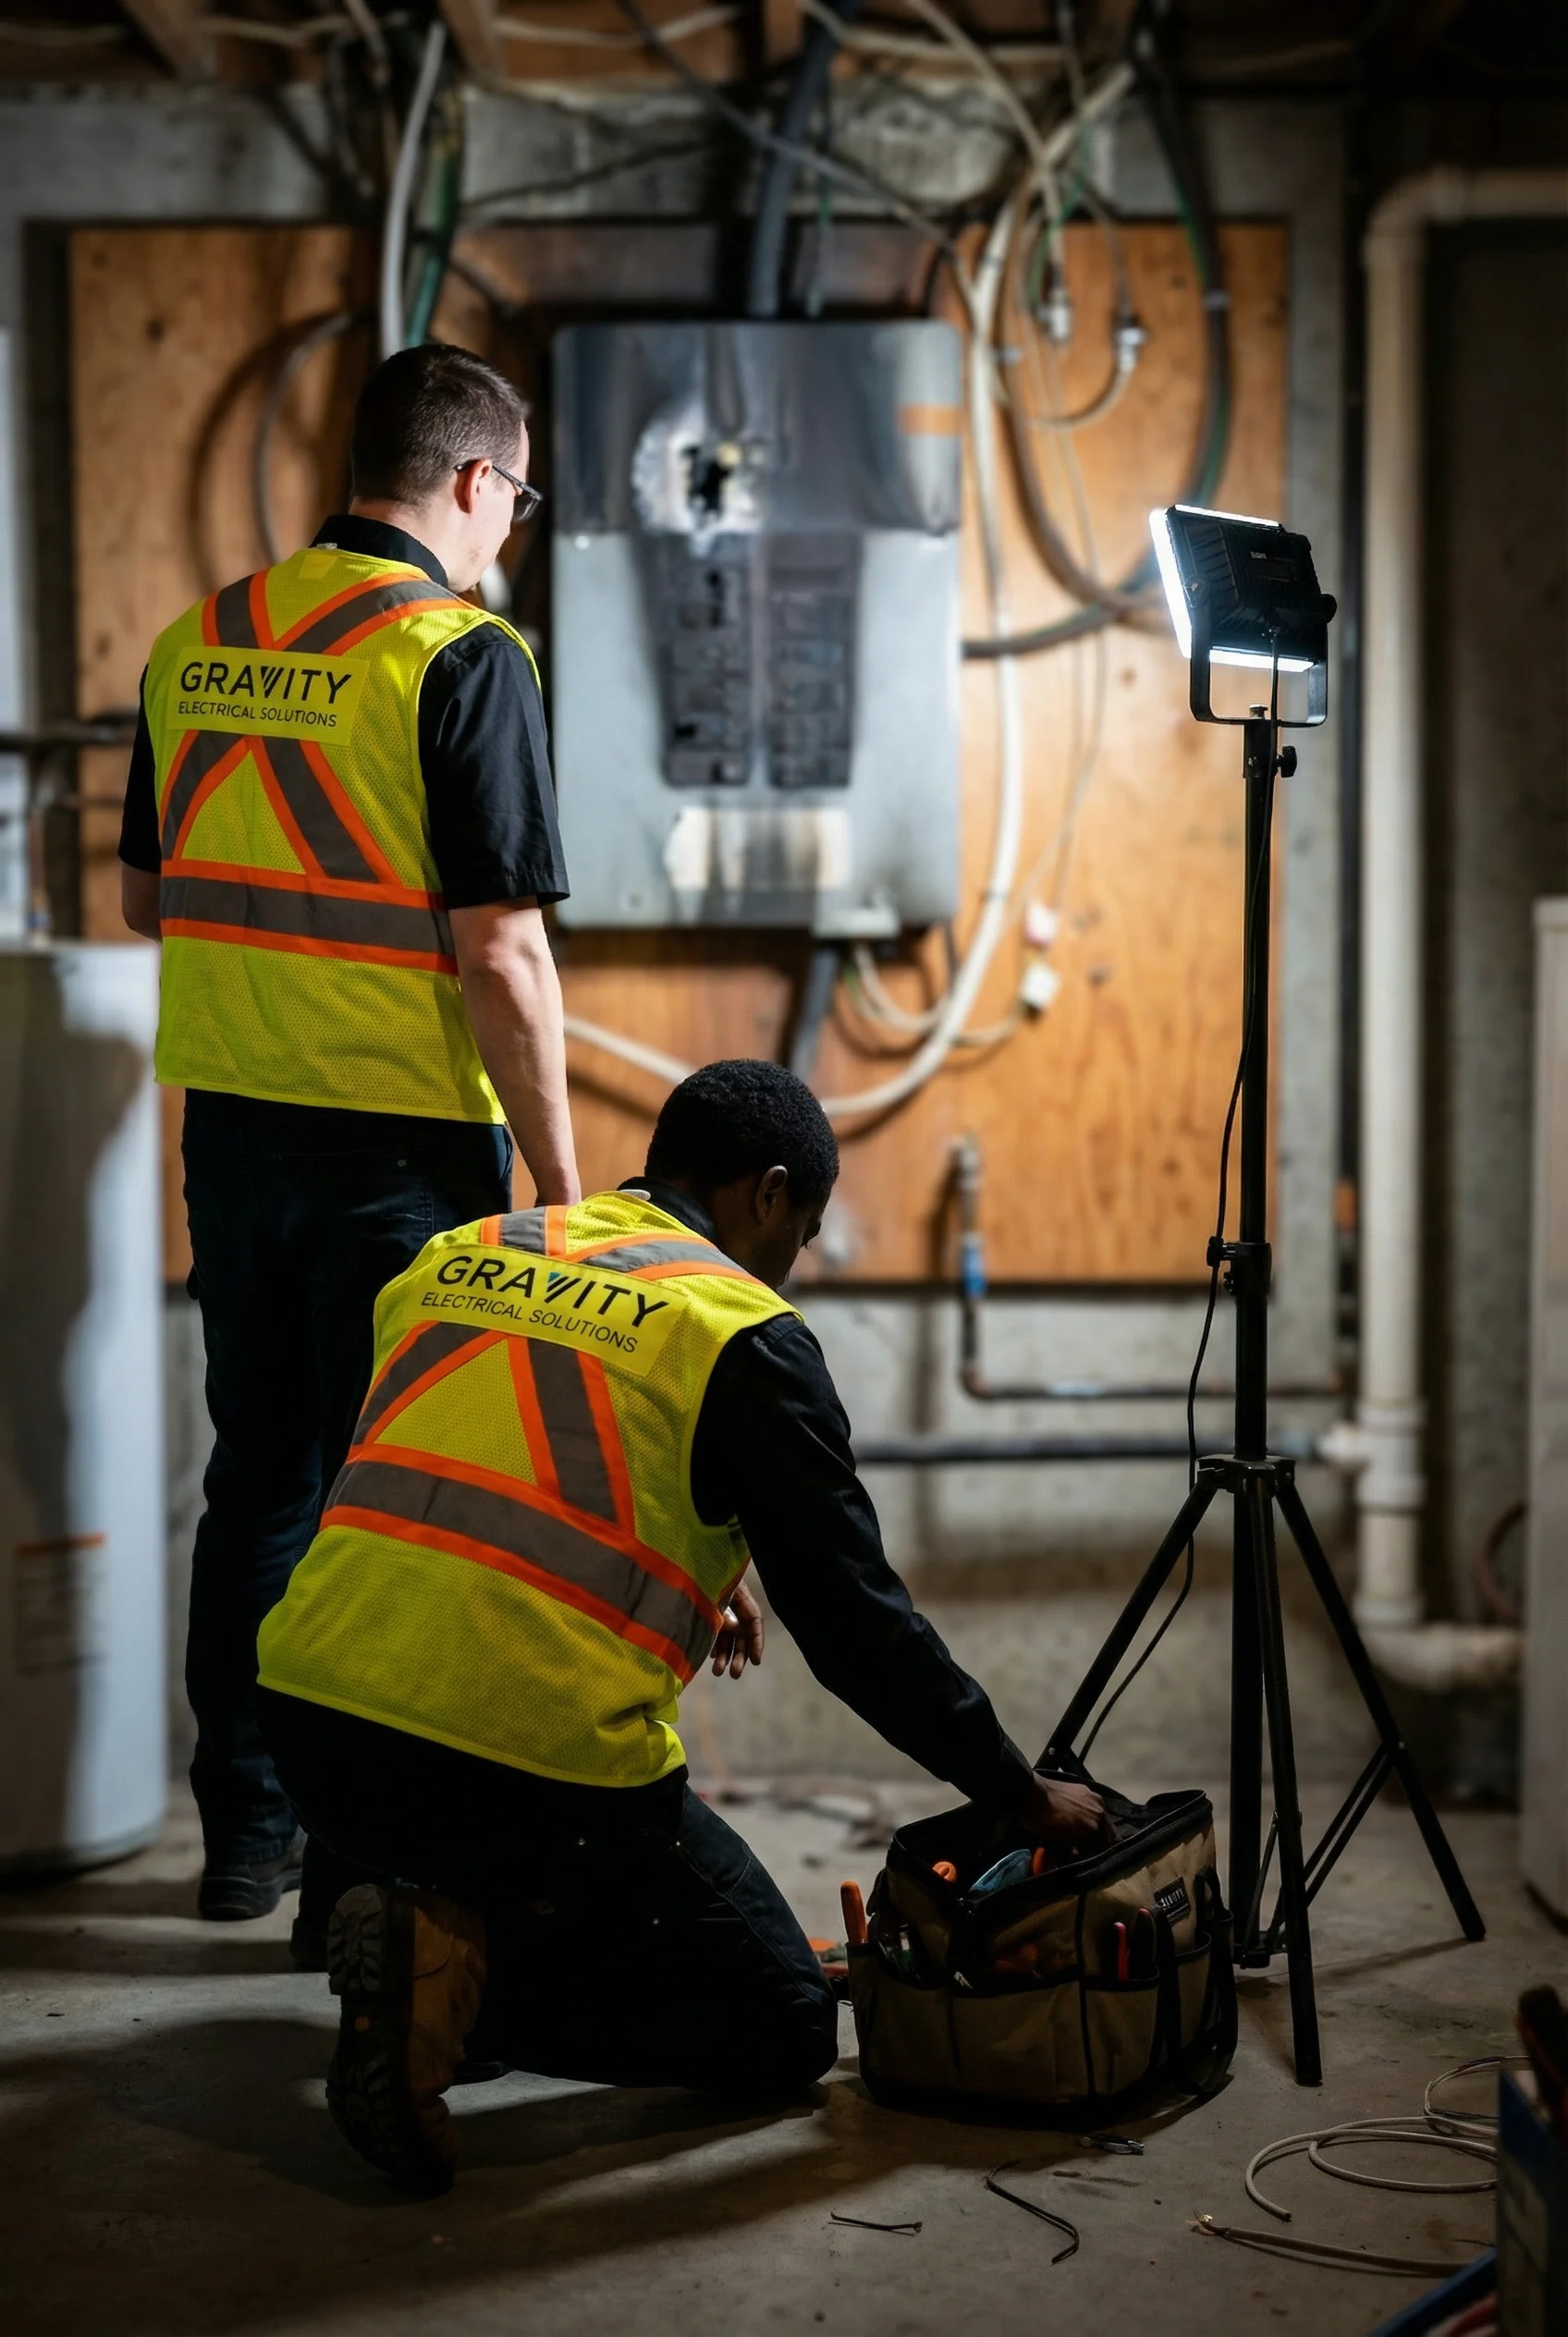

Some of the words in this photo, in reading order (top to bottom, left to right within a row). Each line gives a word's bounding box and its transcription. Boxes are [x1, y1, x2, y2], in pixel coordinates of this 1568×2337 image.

[180, 662, 352, 704] GRAVITY
[178, 701, 256, 720] ELECTRICAL
[260, 707, 337, 728] SOLUTIONS
[436, 1255, 669, 1328] GRAVITY
[421, 1291, 522, 1321] ELECTRICAL
[529, 1309, 639, 1353] SOLUTIONS
